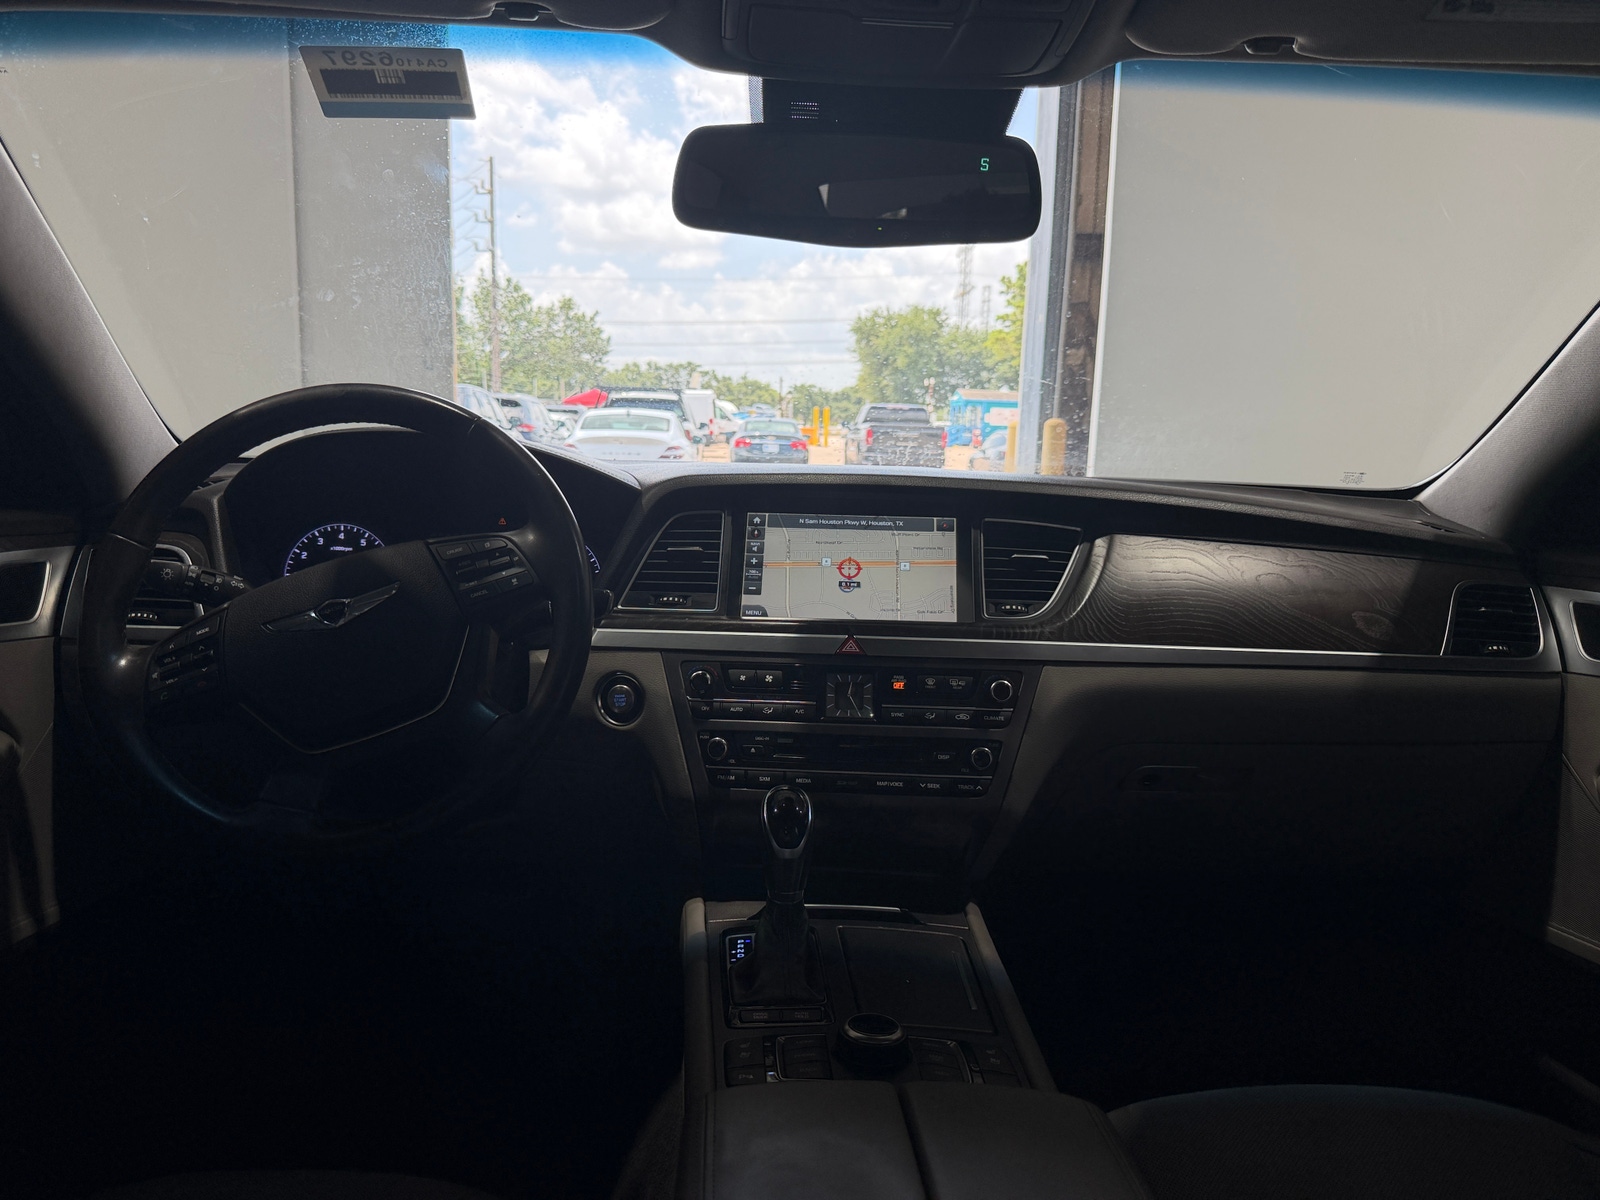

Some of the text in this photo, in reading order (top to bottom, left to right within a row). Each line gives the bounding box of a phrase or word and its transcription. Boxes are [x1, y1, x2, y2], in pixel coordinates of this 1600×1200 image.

[980, 157, 990, 171] S
[868, 519, 895, 527] Houston,
[338, 532, 345, 540] 4
[317, 537, 324, 546] 3
[360, 538, 367, 547] 5
[301, 551, 308, 559] 2
[892, 682, 905, 690] OFF
